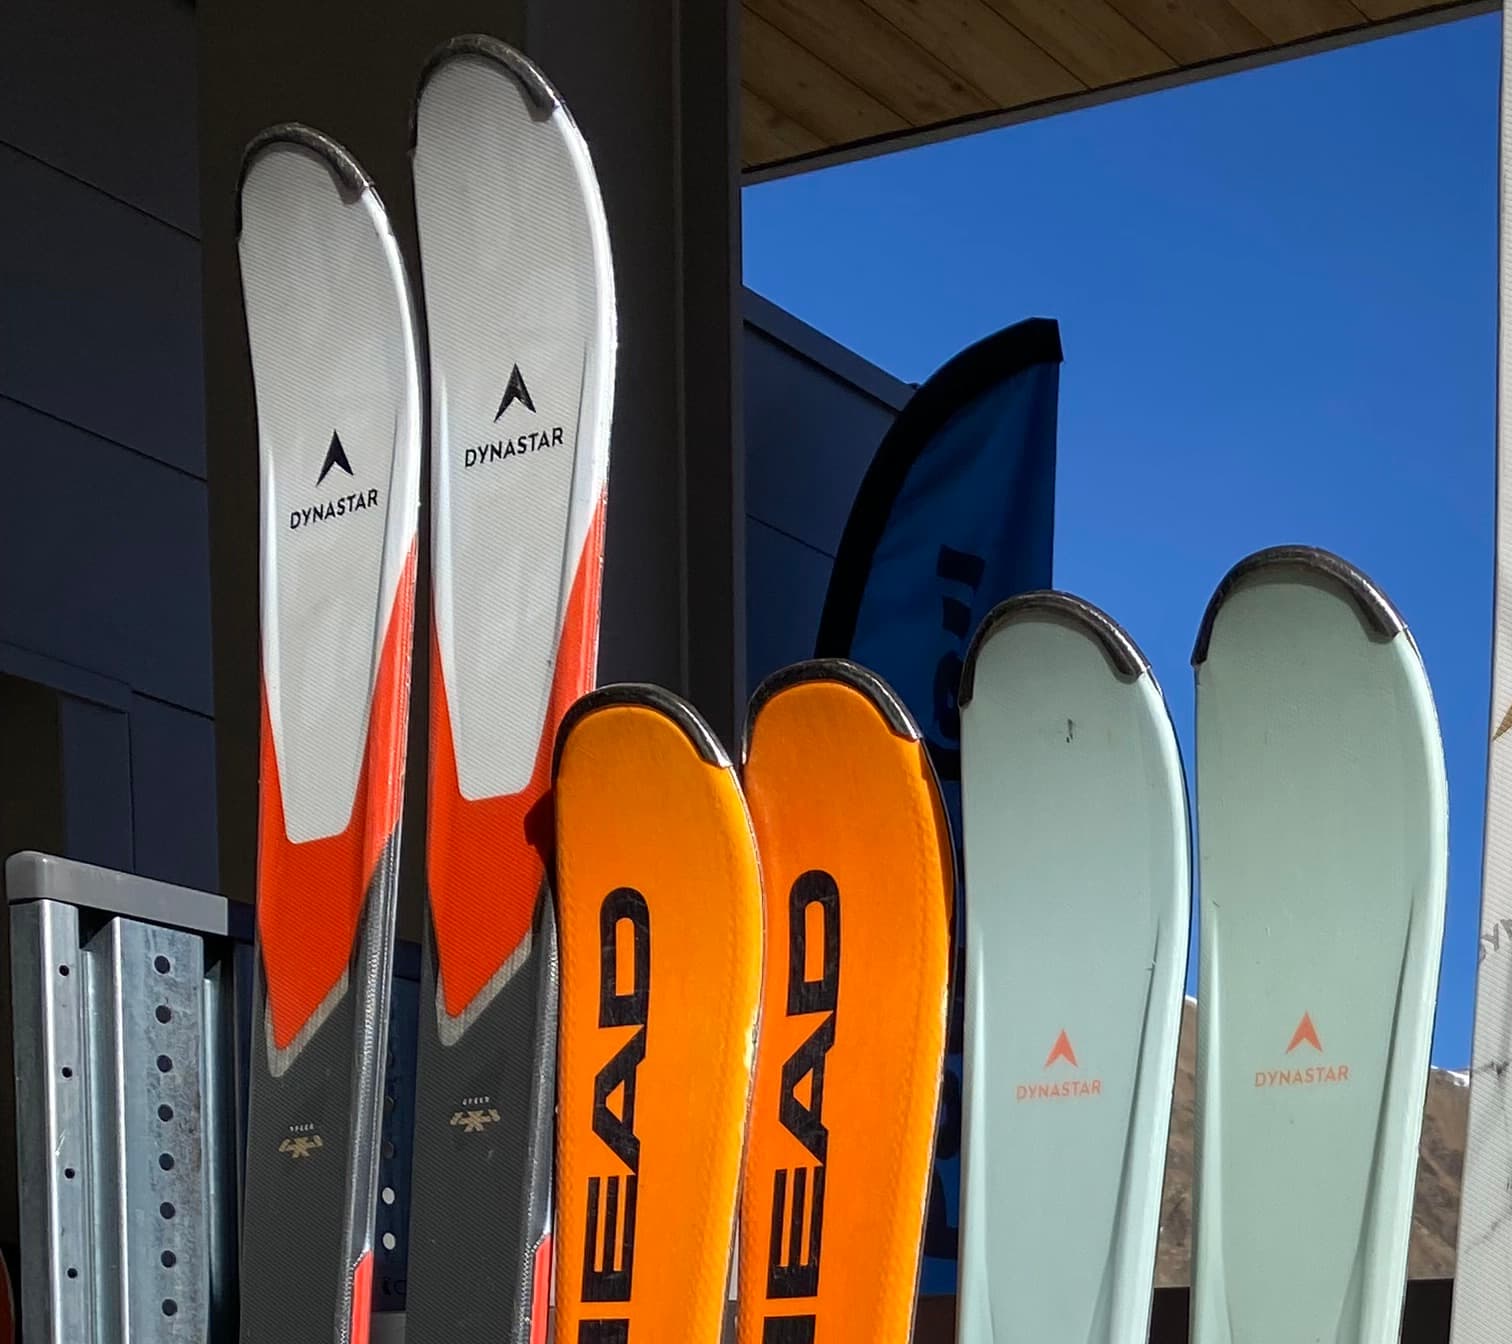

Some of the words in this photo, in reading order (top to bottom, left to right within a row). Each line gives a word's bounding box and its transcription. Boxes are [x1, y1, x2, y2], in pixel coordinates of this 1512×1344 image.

[464, 426, 564, 469] DYNASTAR
[290, 487, 379, 530] DYNASTAR
[1015, 1079, 1102, 1101] DYNASTAR
[1253, 1064, 1349, 1089] DYNASTAR
